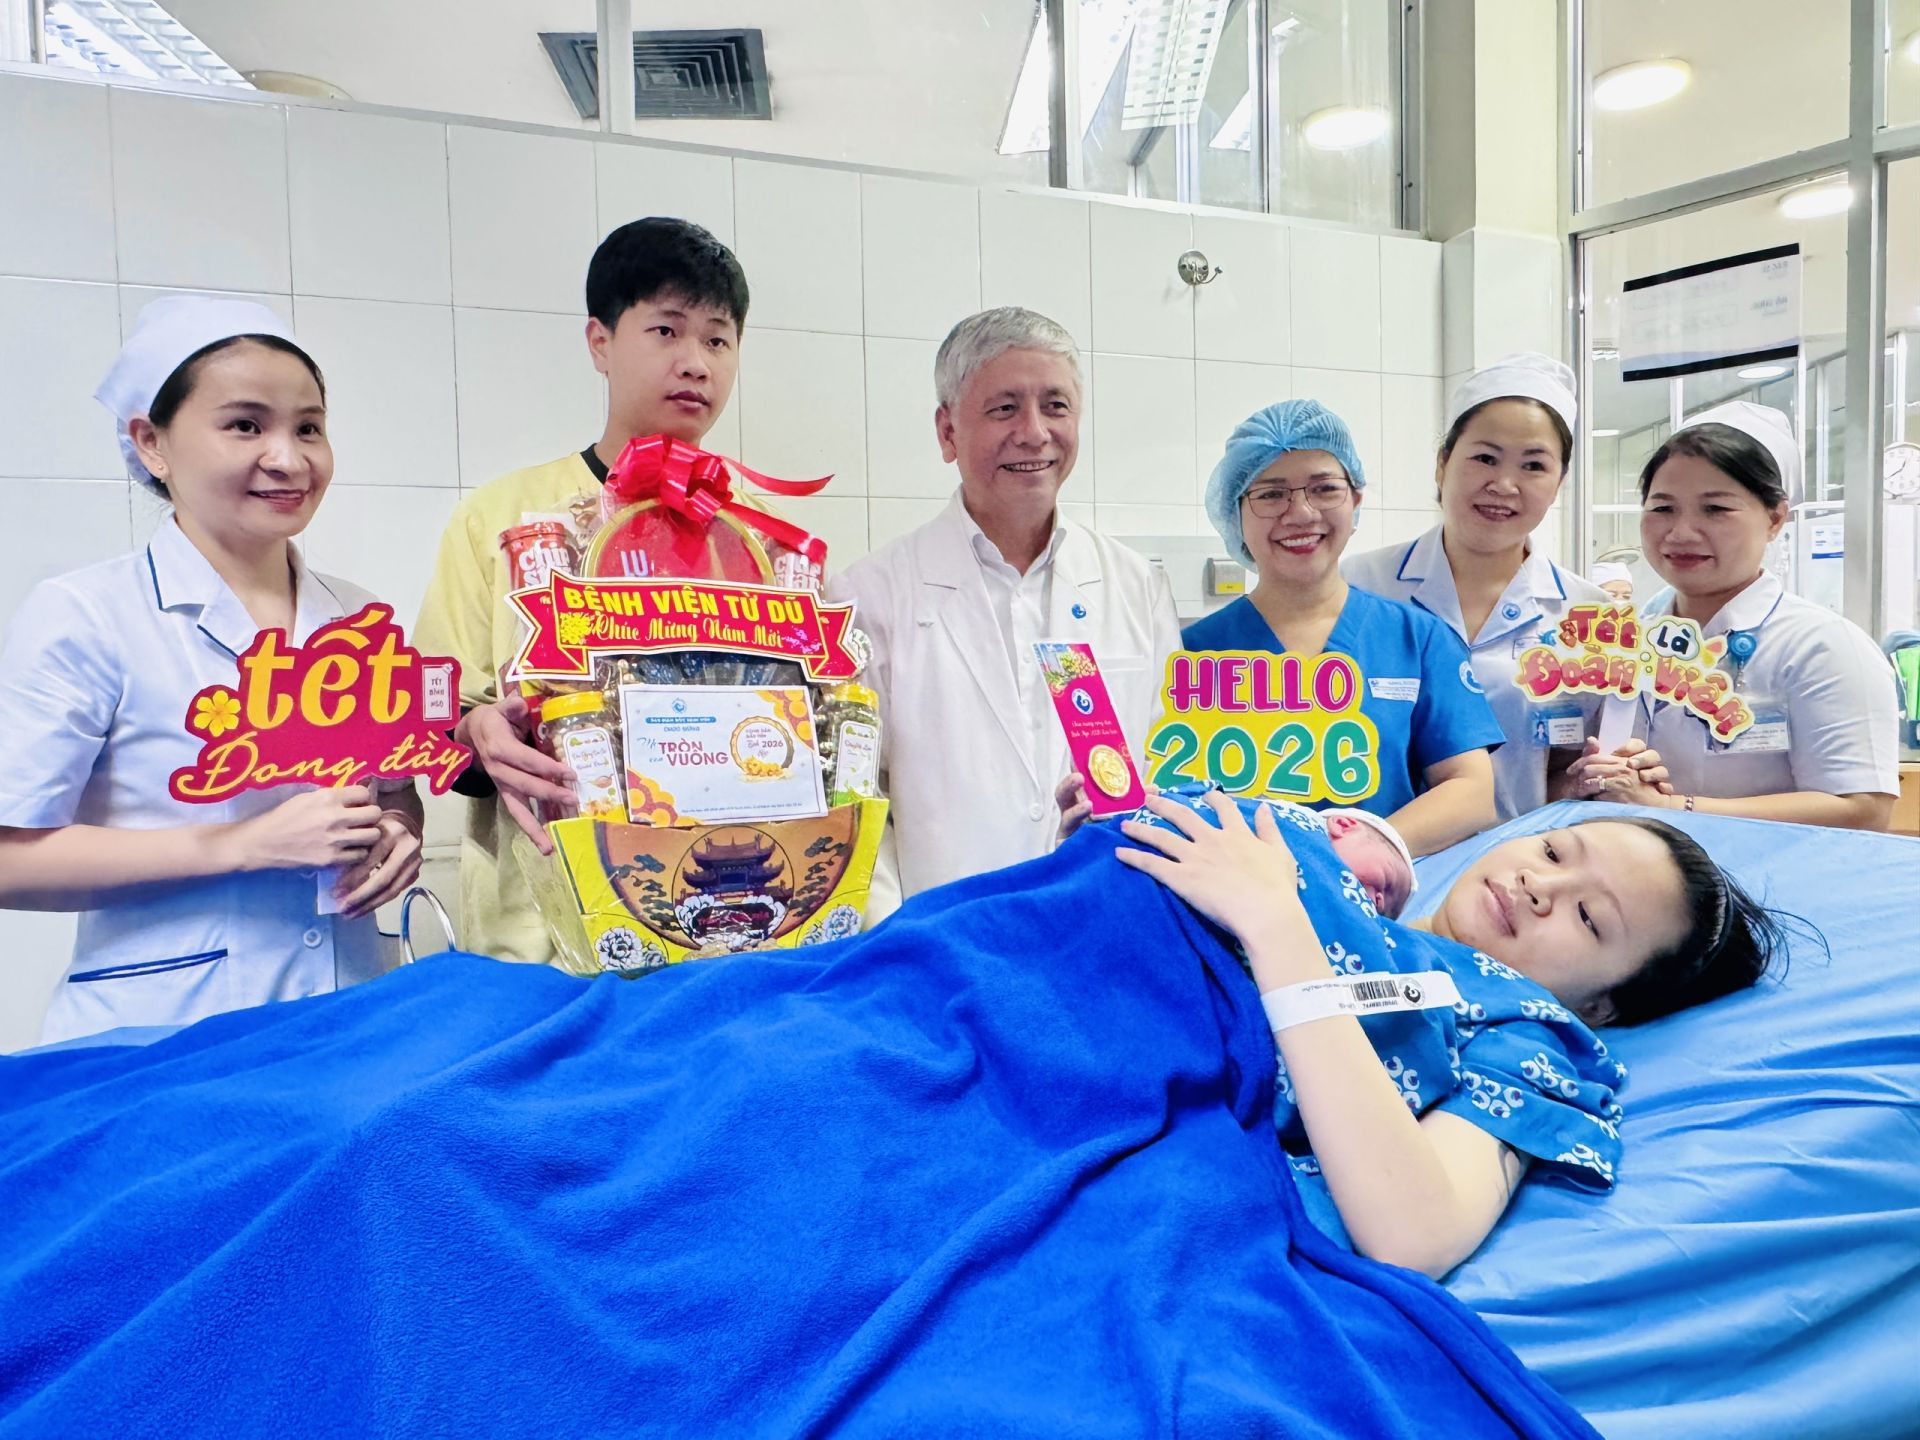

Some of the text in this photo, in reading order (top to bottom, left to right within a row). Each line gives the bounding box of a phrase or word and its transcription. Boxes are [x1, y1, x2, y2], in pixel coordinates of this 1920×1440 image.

[621, 549, 649, 577] LU
[563, 585, 805, 624] BỆNH VIỆN TỪ DŨ
[595, 614, 784, 648] Chúc Mừng Năm Mới
[1657, 625, 1691, 655] Là
[243, 609, 413, 730] tết
[1167, 655, 1356, 713] HELLO
[1516, 644, 1637, 697] Đoàn
[658, 738, 703, 754] TRÒN
[667, 749, 729, 767] VUÔNG
[761, 740, 784, 748] 2026
[1149, 719, 1371, 797] 2026
[176, 729, 470, 796] Đong đầy
